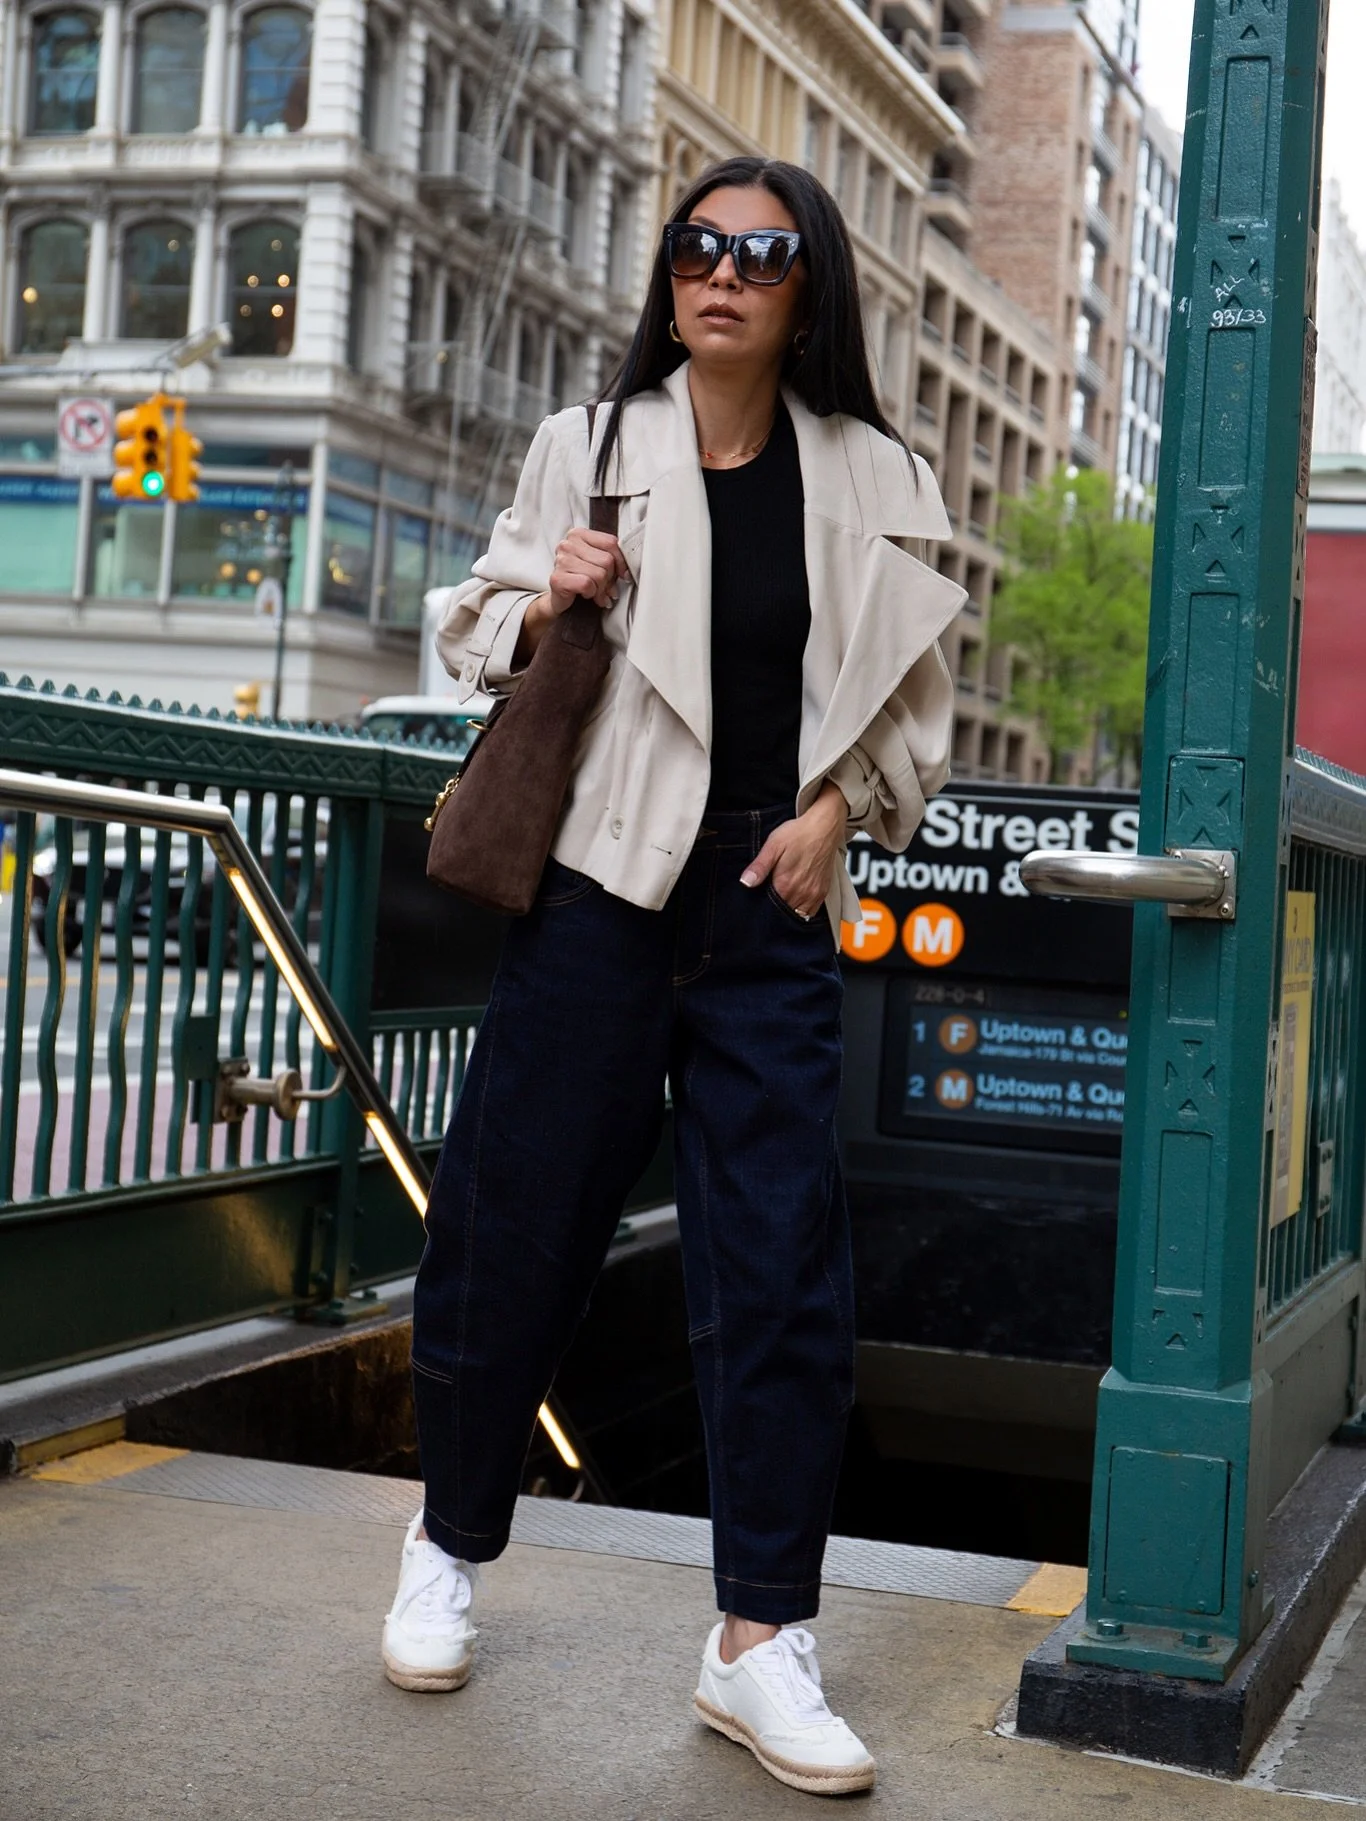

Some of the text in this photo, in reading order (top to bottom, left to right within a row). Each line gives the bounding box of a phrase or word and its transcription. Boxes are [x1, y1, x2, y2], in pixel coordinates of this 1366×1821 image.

[921, 799, 1094, 852] Street
[845, 850, 989, 894] Uptown
[852, 909, 954, 955] F M
[912, 1018, 1128, 1050] 1 F Uptown & Qu
[908, 1072, 1125, 1106] 2 M Uptown & Qu
